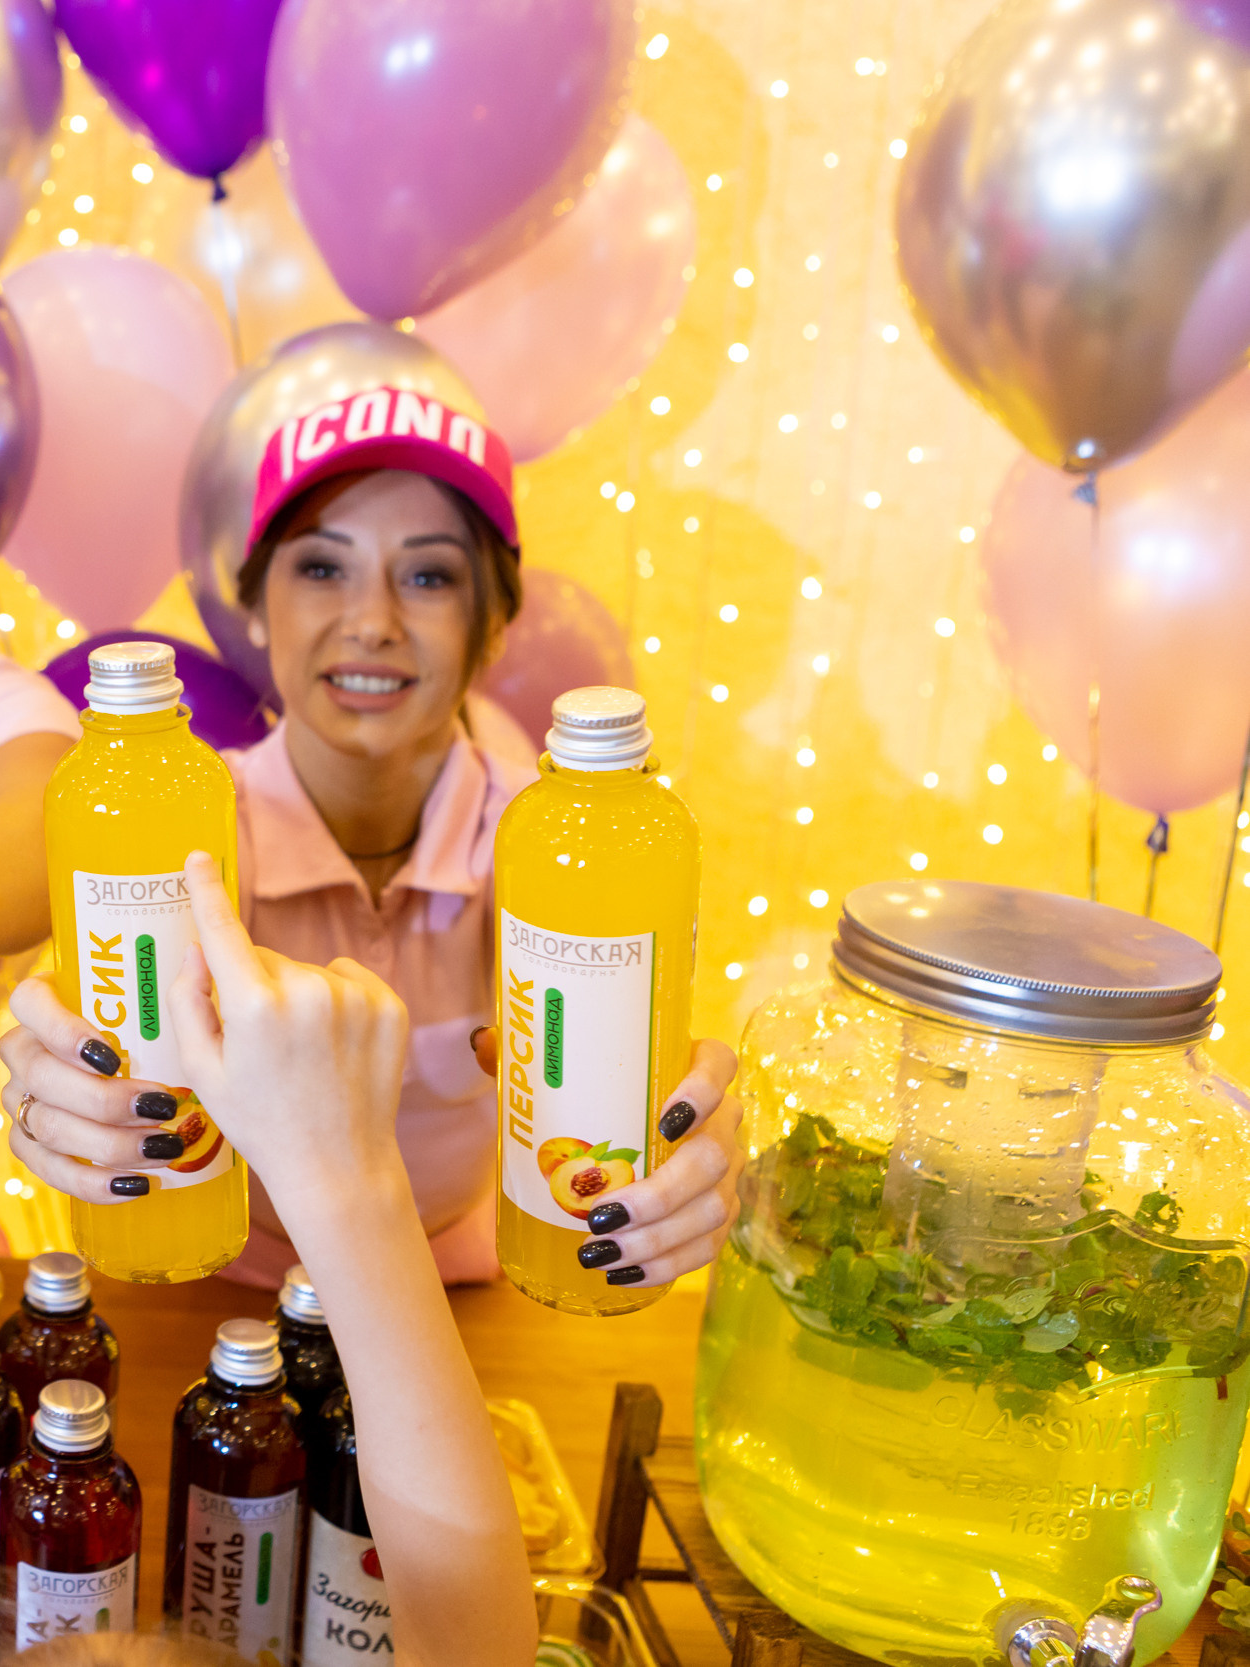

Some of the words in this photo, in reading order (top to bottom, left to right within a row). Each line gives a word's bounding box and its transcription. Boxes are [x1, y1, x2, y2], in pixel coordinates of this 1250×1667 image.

[280, 389, 486, 483] ICONO
[86, 876, 190, 906] ЗАГОРСК
[106, 904, 192, 916] солодоварн
[509, 920, 642, 967] ЗАГОРСКАЯ
[509, 968, 534, 1150] ПЕРСИК
[28, 1566, 128, 1594] ЗАГОРСКАЯ
[189, 1527, 217, 1639] РУША-
[218, 1533, 245, 1648] АРАМЕЛЬ
[324, 1617, 395, 1654] КОЛ
